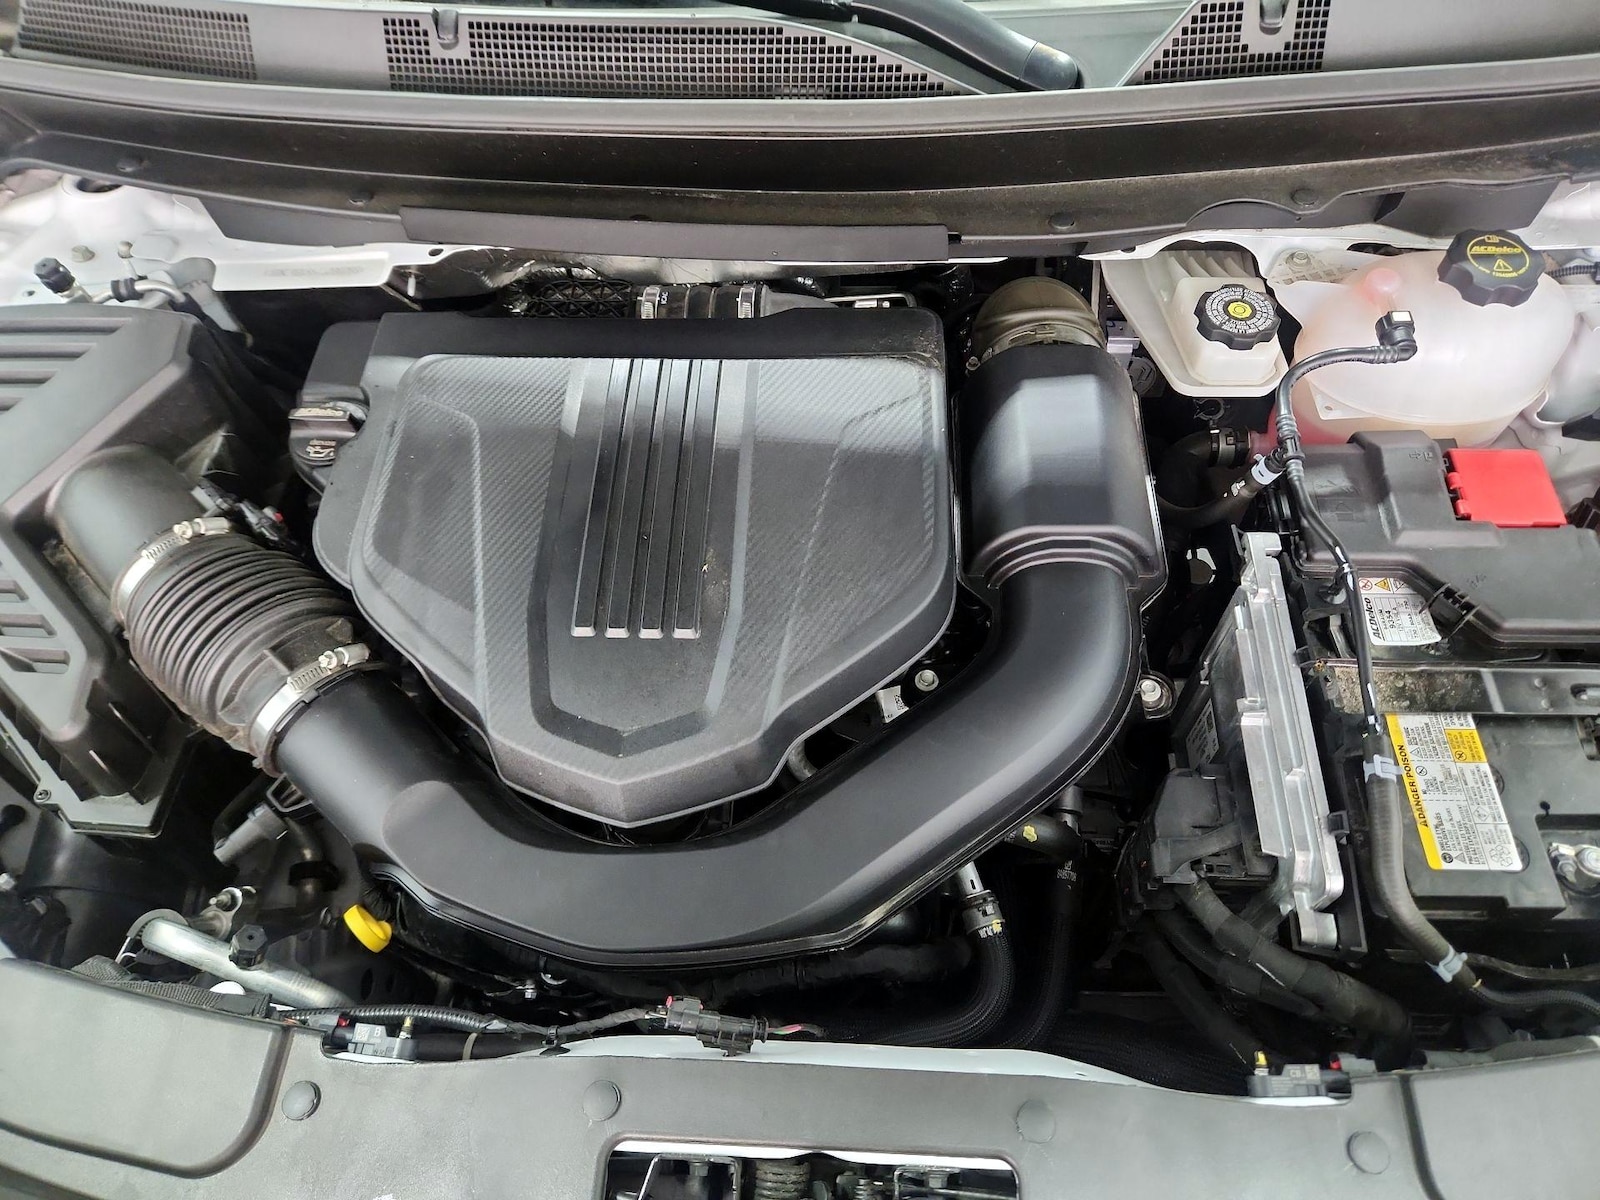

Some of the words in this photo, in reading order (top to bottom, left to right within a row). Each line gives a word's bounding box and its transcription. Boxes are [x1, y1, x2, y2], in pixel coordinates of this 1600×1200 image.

[1471, 245, 1522, 254] ACDelco
[1365, 598, 1381, 639] ACDelco
[1385, 610, 1396, 628] 9354
